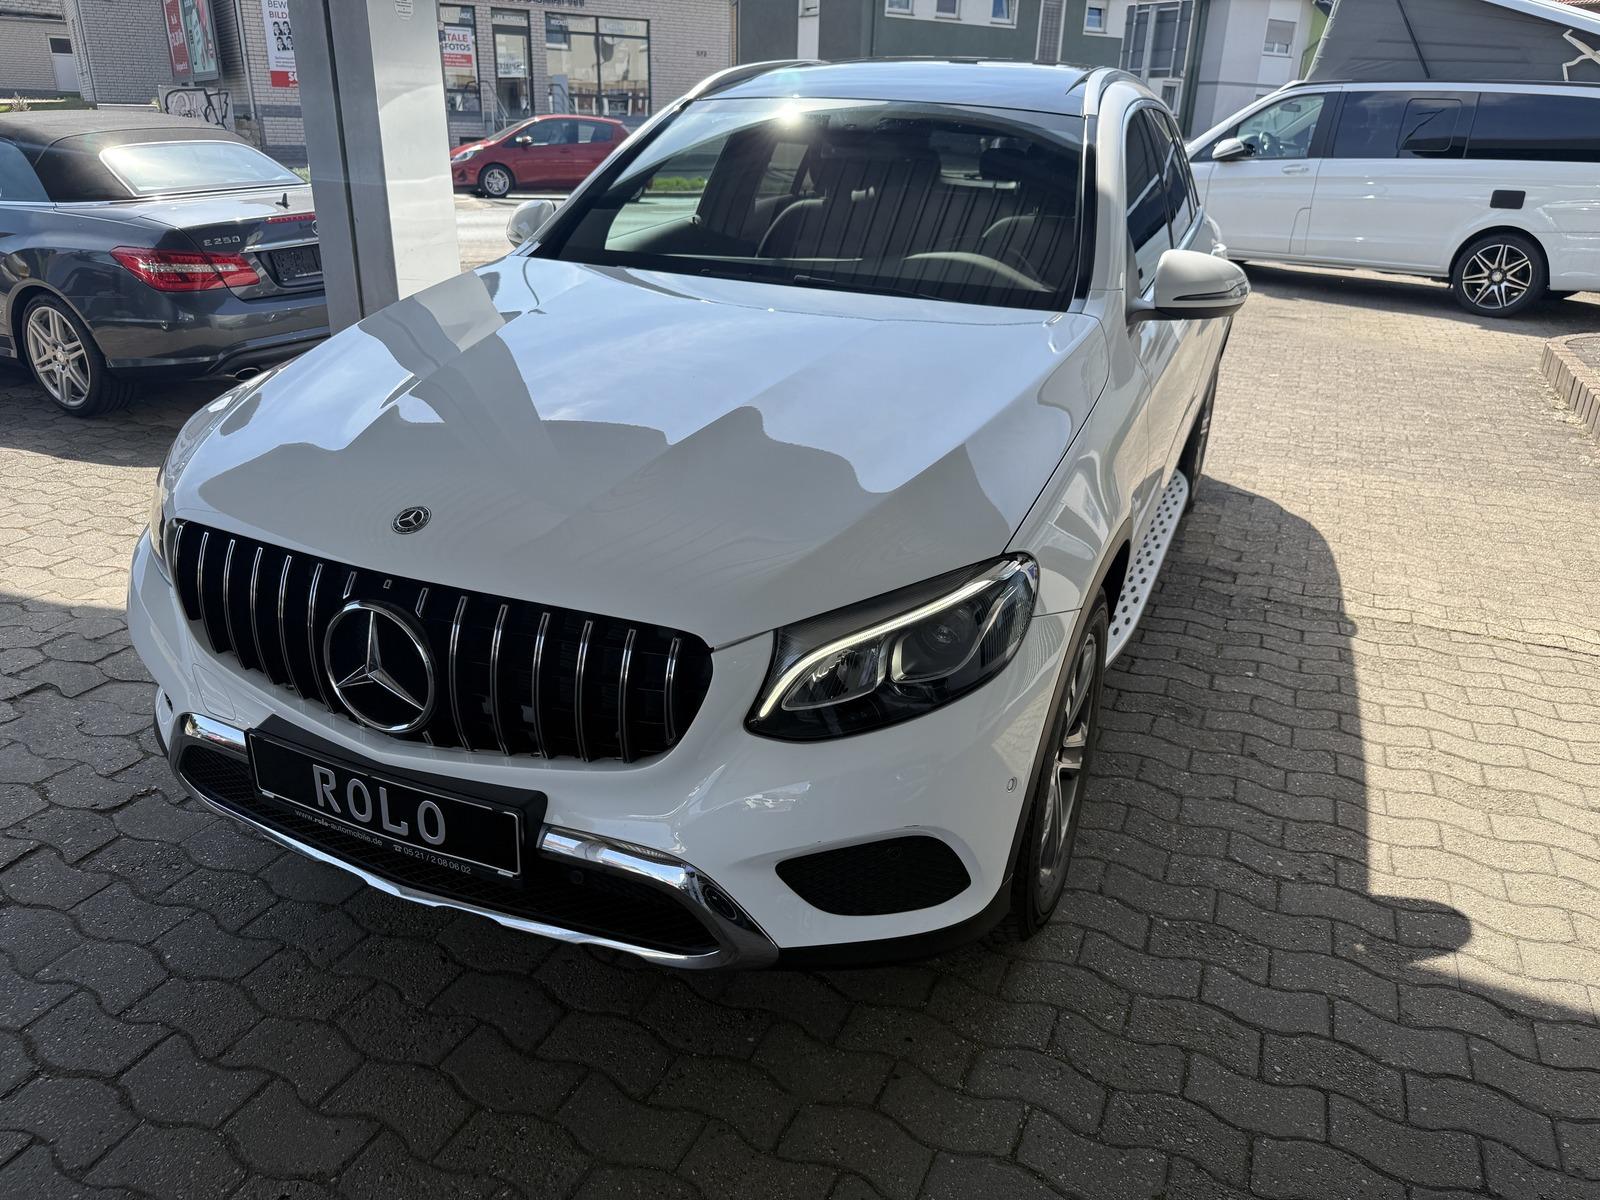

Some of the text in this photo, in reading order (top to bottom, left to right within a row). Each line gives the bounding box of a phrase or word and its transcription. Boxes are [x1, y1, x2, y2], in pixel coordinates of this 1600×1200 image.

[203, 235, 241, 247] E 250
[312, 764, 446, 846] ROLO
